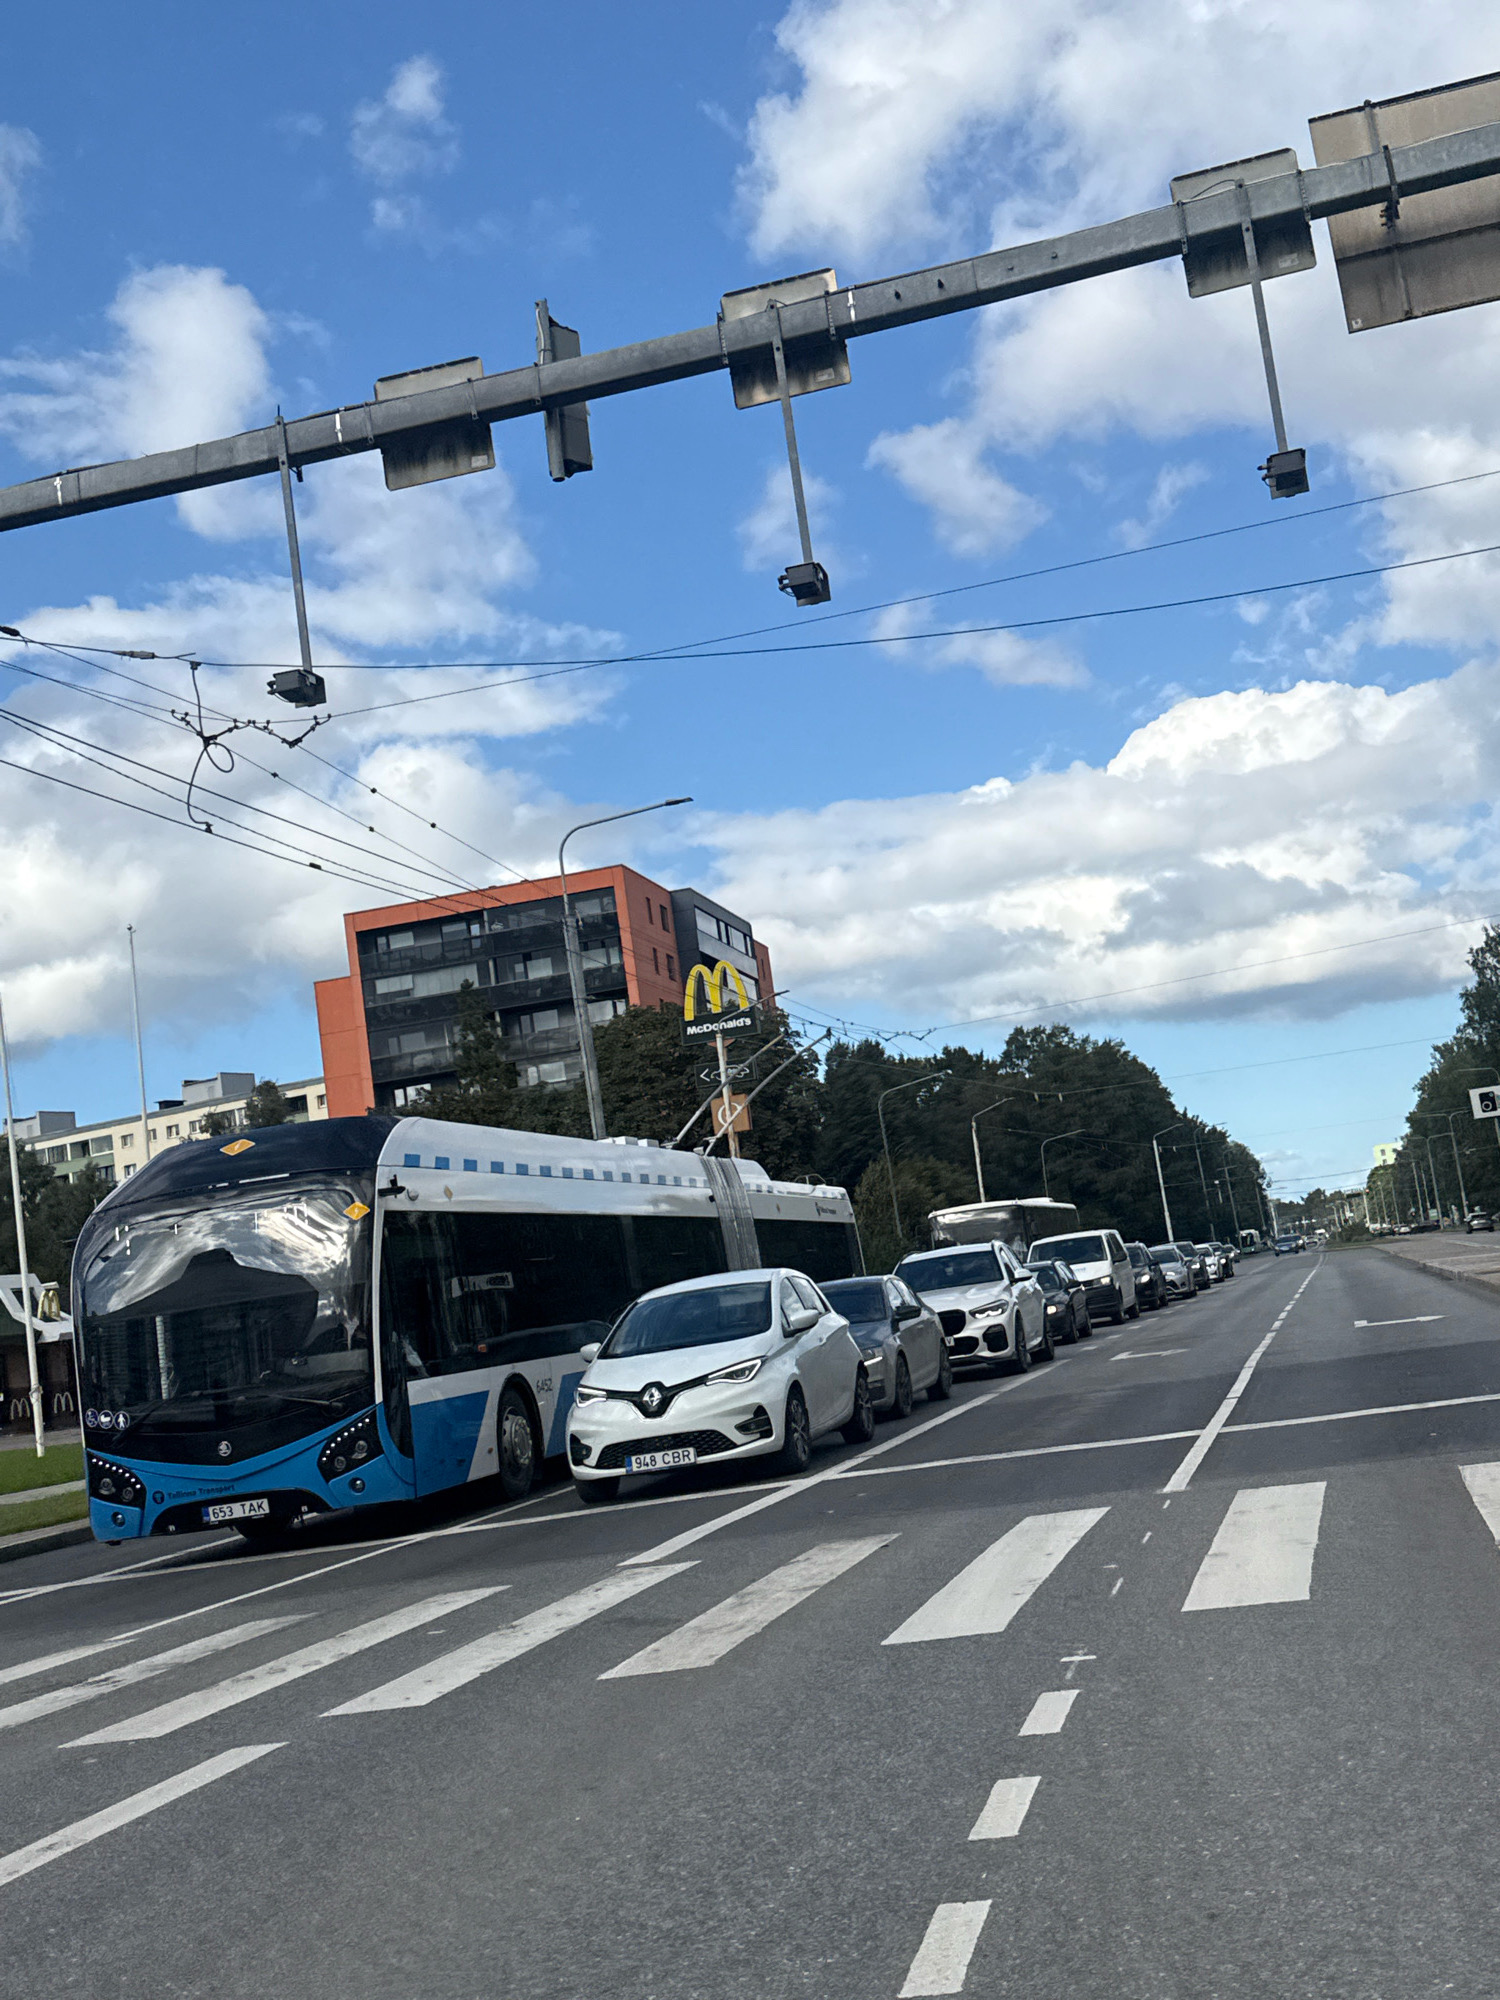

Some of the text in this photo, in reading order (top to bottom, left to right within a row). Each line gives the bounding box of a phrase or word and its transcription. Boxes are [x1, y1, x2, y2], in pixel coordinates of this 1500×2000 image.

[687, 1017, 751, 1035] McDonald's
[536, 1377, 554, 1394] 6452
[635, 1449, 692, 1469] 948 CBR
[197, 1483, 235, 1496] Transport
[211, 1505, 234, 1519] 653
[239, 1500, 266, 1515] TAK
